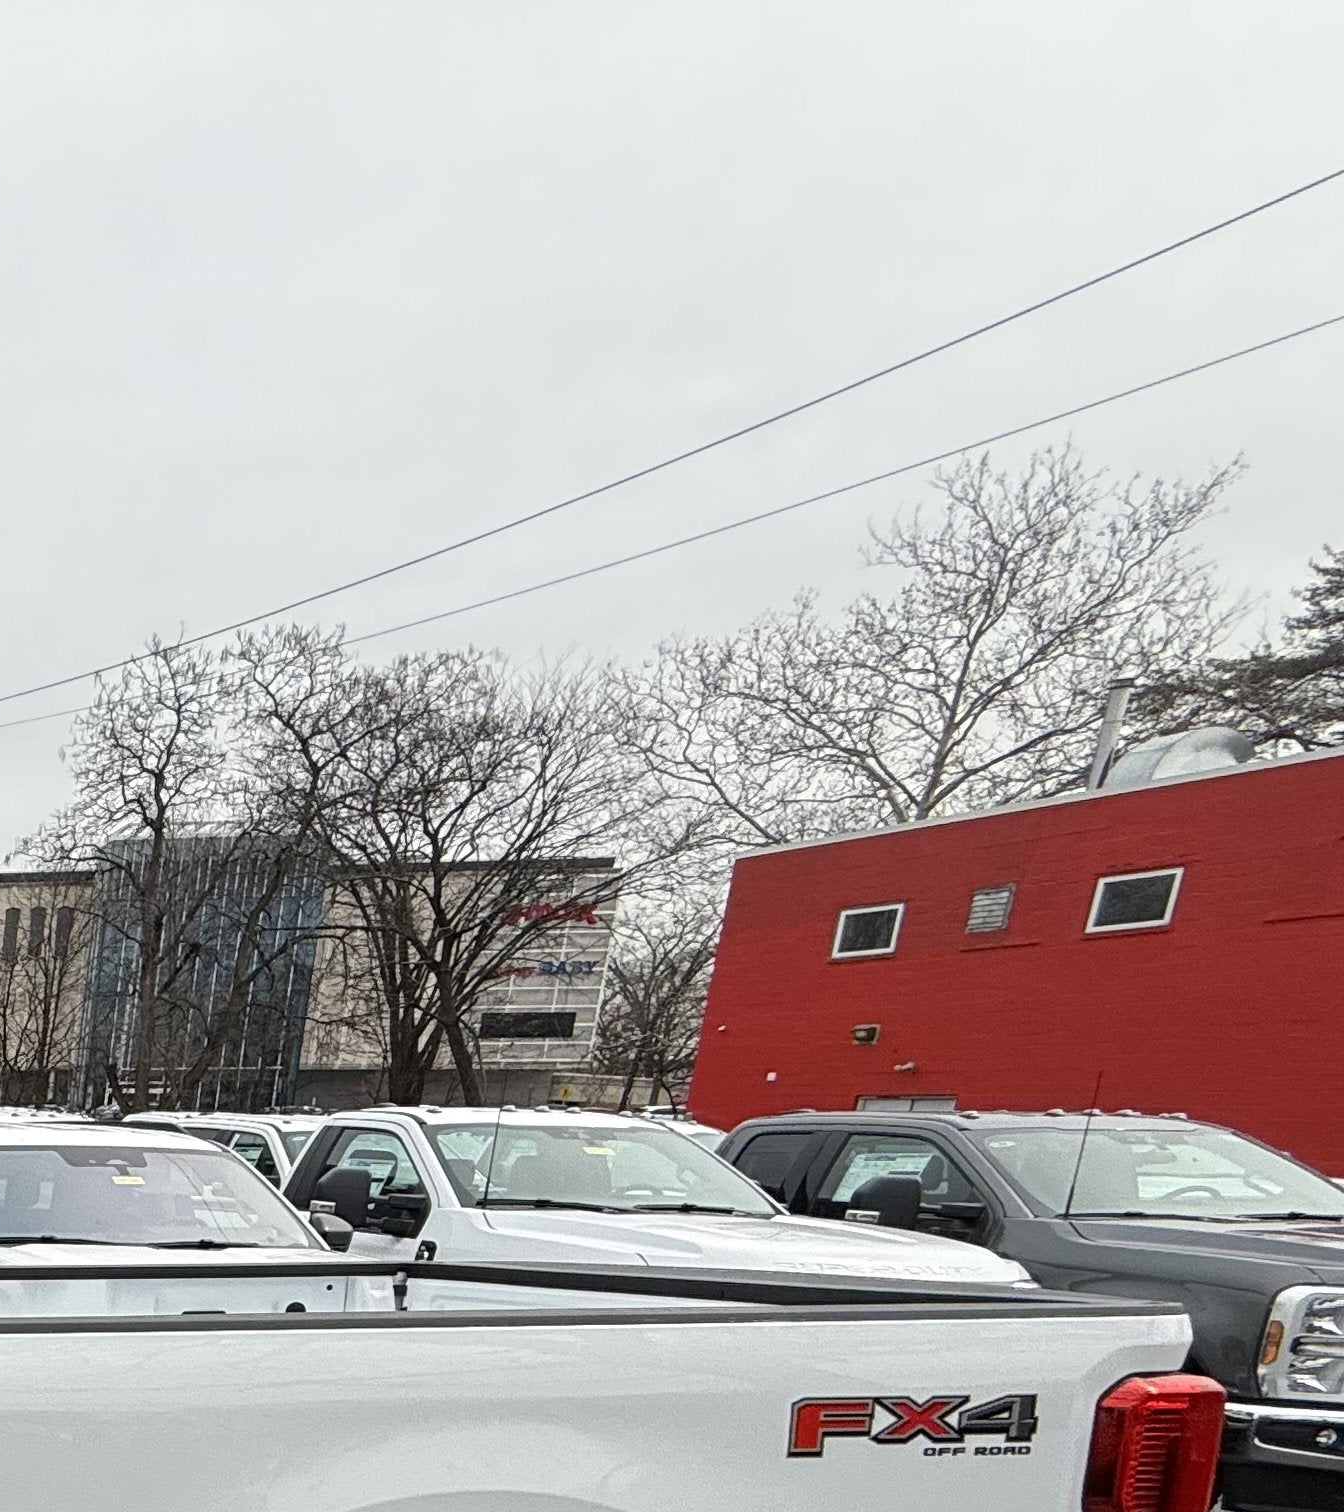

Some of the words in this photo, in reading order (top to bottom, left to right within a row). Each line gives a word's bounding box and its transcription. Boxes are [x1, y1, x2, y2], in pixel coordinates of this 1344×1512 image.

[786, 1393, 1039, 1459] FX4
[923, 1447, 967, 1457] OFF
[974, 1446, 1032, 1457] ROAD
